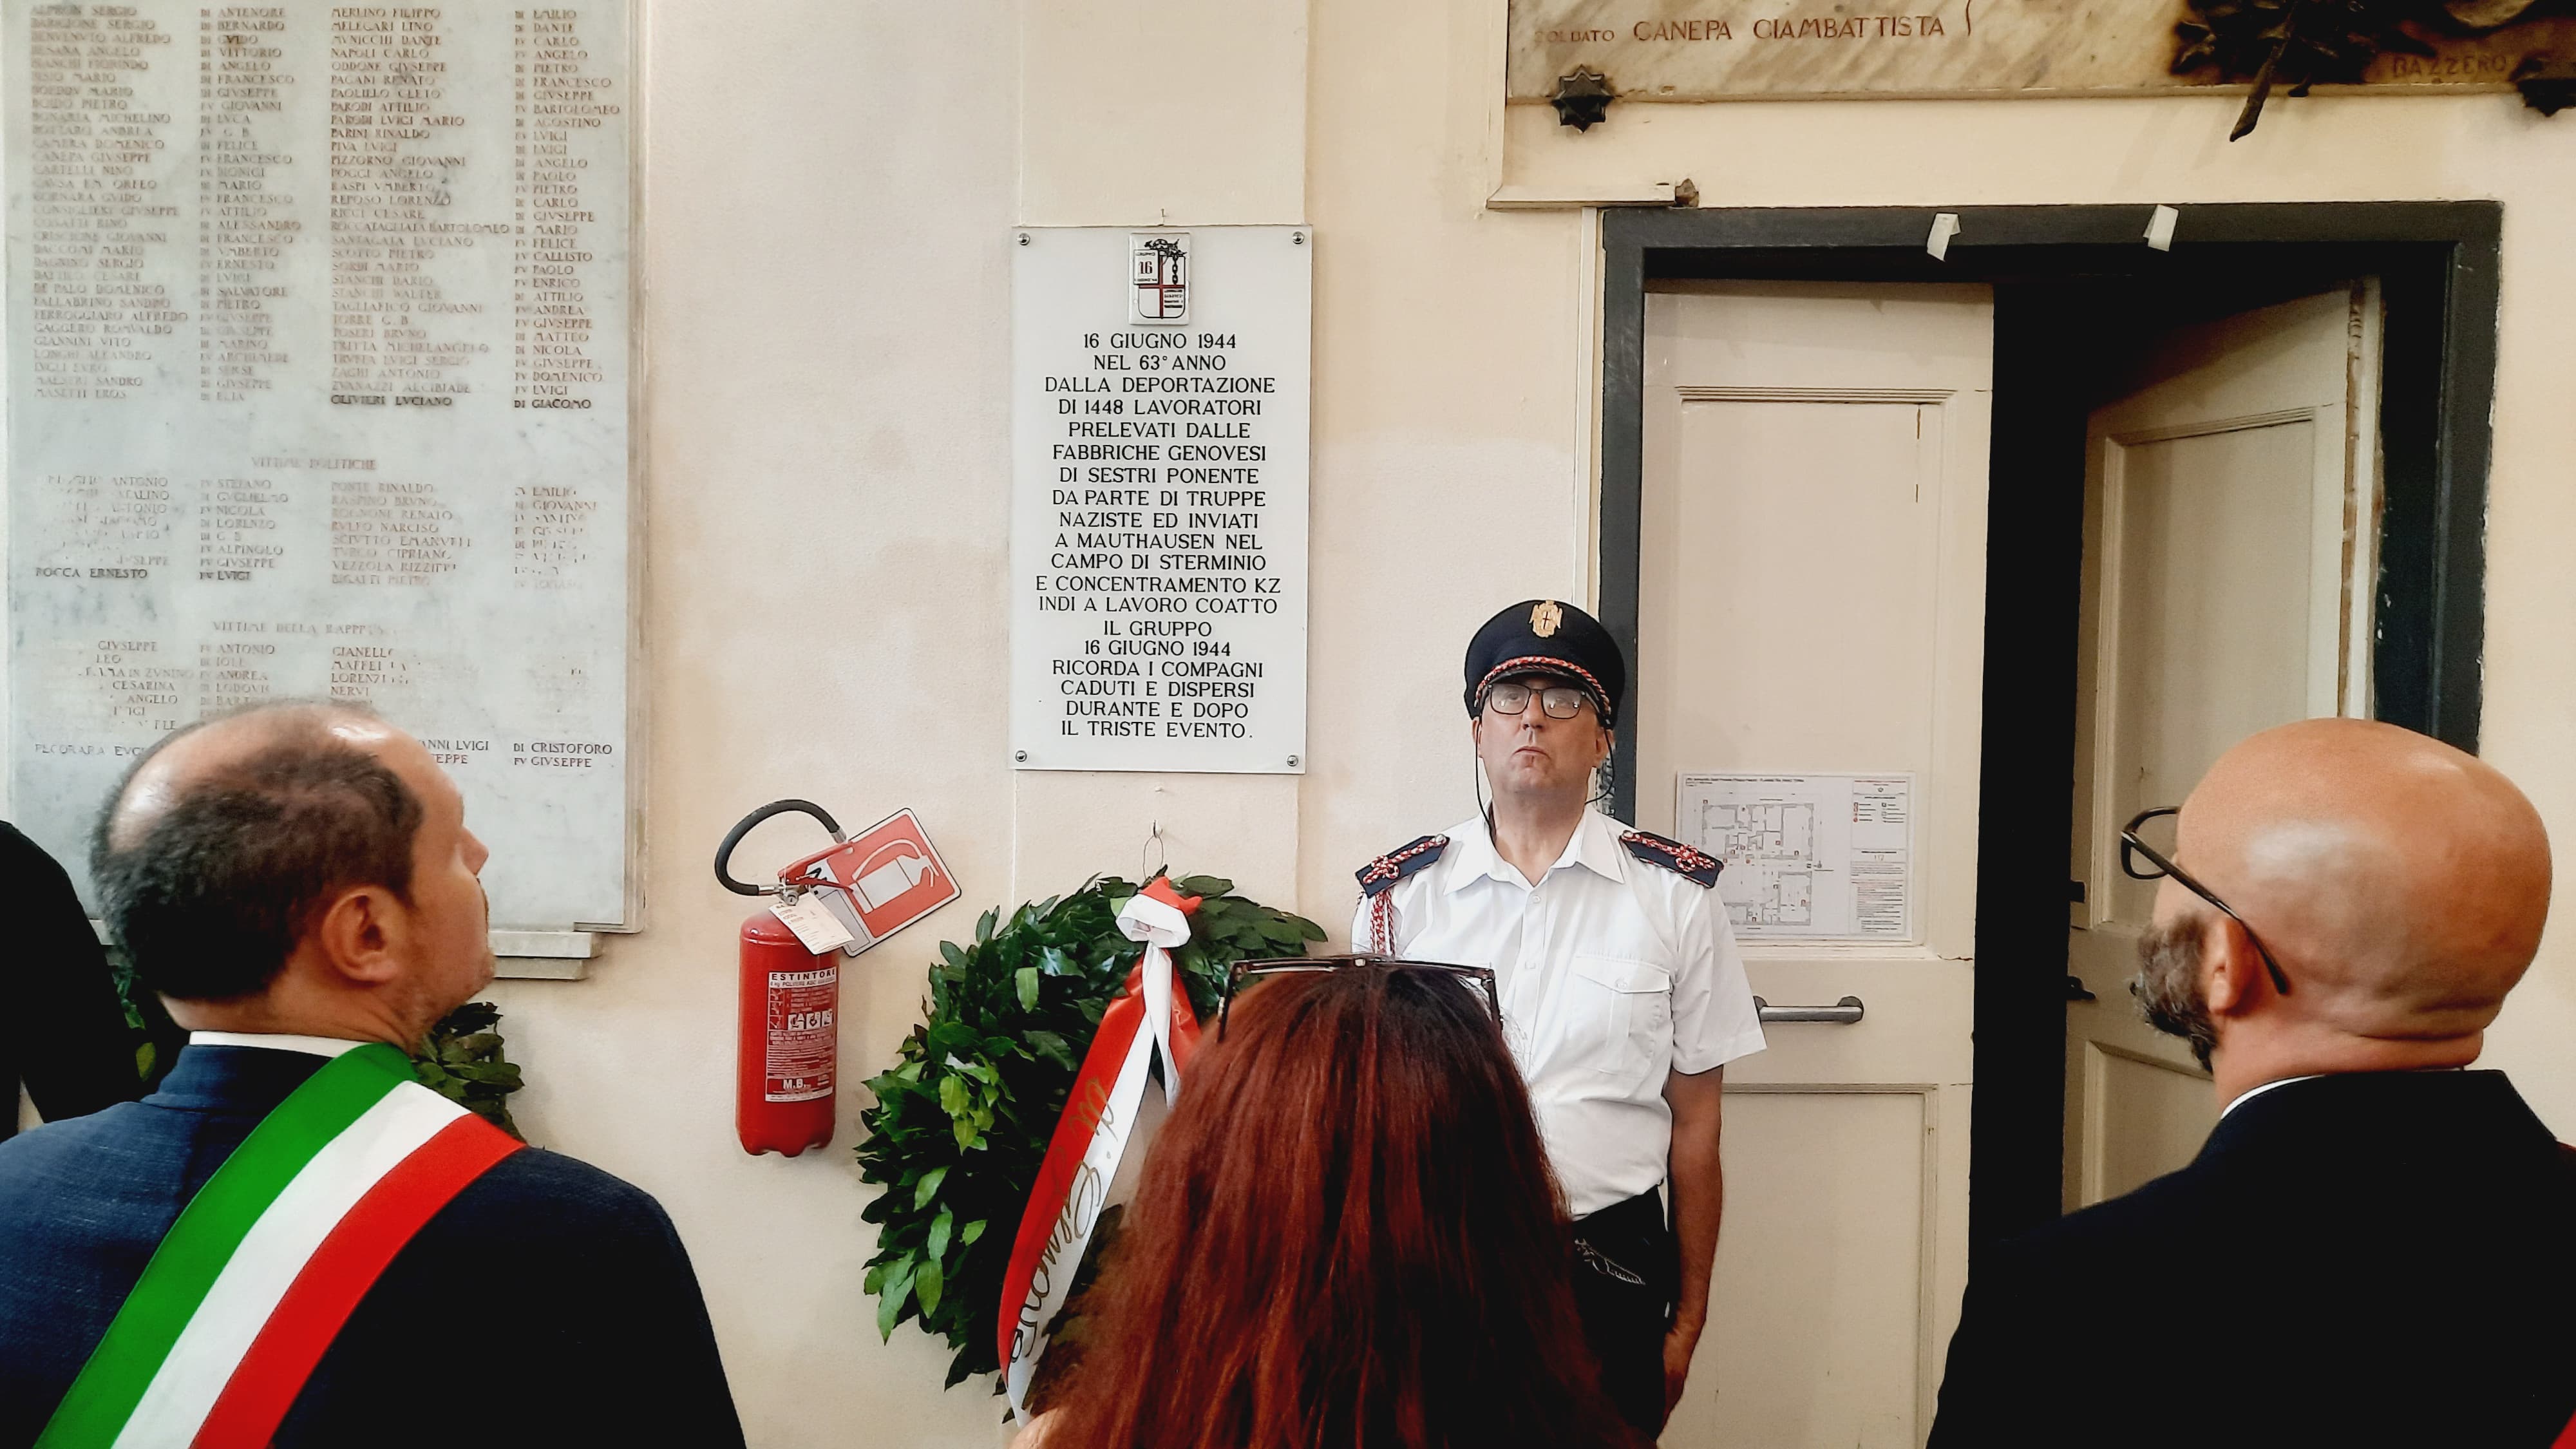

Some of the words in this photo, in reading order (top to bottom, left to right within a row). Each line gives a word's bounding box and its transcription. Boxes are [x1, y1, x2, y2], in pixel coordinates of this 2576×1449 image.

[1633, 20, 1733, 41] CANEPA
[383, 49, 430, 59] CARLO
[419, 116, 465, 126] MARIO
[533, 198, 579, 208] CARLO
[533, 265, 574, 275] PAOLO
[1139, 261, 1153, 275] 16
[1084, 333, 1099, 348] 16
[1110, 333, 1187, 349] GIUGNO
[1198, 333, 1236, 349] 1944
[533, 345, 583, 356] NICOLA
[1094, 354, 1131, 370] NEL
[1171, 355, 1226, 371] ANNO
[1045, 377, 1111, 393] DALLA
[1122, 377, 1275, 393] DEPORTAZIONE
[1059, 399, 1076, 415] DI
[1085, 399, 1123, 415] 1448
[1134, 399, 1261, 415] LAVORATORI
[1068, 422, 1175, 438] PRELEVATI
[1186, 422, 1251, 439] DALLE
[1053, 444, 1160, 460] FABBRICHE
[1168, 445, 1266, 461] GENOVESI
[1059, 467, 1077, 482] DI
[1088, 467, 1156, 483] SESTRI
[1167, 468, 1259, 484] PONENTE
[1053, 489, 1079, 505] DA
[1084, 489, 1150, 506] PARTE
[1160, 490, 1178, 506] DI
[1186, 491, 1266, 507] TRUPPE
[1059, 511, 1142, 528] NAZISTE
[1153, 513, 1178, 528] ED
[1189, 513, 1258, 529] INVIATI
[1054, 533, 1069, 548] A
[1077, 533, 1215, 549] MAUTHAUSEN
[1226, 534, 1263, 550] NEL
[1051, 553, 1123, 569] CAMPO
[1131, 554, 1149, 569] DI
[1159, 554, 1266, 571] STERMINIO
[1036, 575, 1047, 591] E
[1056, 575, 1247, 593] CONCENTRAMENTO
[1255, 578, 1281, 593] KZ
[1039, 596, 1075, 611] INDI
[1083, 597, 1097, 612] A
[1106, 596, 1188, 613] LAVORO
[1195, 598, 1278, 614] COATTO
[1104, 620, 1121, 636] IL
[1129, 620, 1212, 637] GRUPPO
[1085, 639, 1100, 655] 16
[1108, 639, 1184, 656] GIUGNO
[1193, 641, 1231, 657] 1944
[1052, 659, 1140, 676] RICORDA
[1149, 661, 1153, 676] I
[1161, 661, 1263, 678] COMPAGNI
[1061, 679, 1135, 696] CADUTI
[1146, 681, 1157, 696] E
[1168, 681, 1255, 698] DISPERSI
[1066, 700, 1160, 717] DURANTE
[1171, 702, 1182, 717] E
[1193, 702, 1249, 719] DOPO
[1062, 719, 1079, 736] IL
[1087, 721, 1155, 737] TRISTE
[513, 743, 524, 753] DI
[531, 742, 612, 755] CRISTOFORO
[772, 968, 835, 980] ESTINTORE
